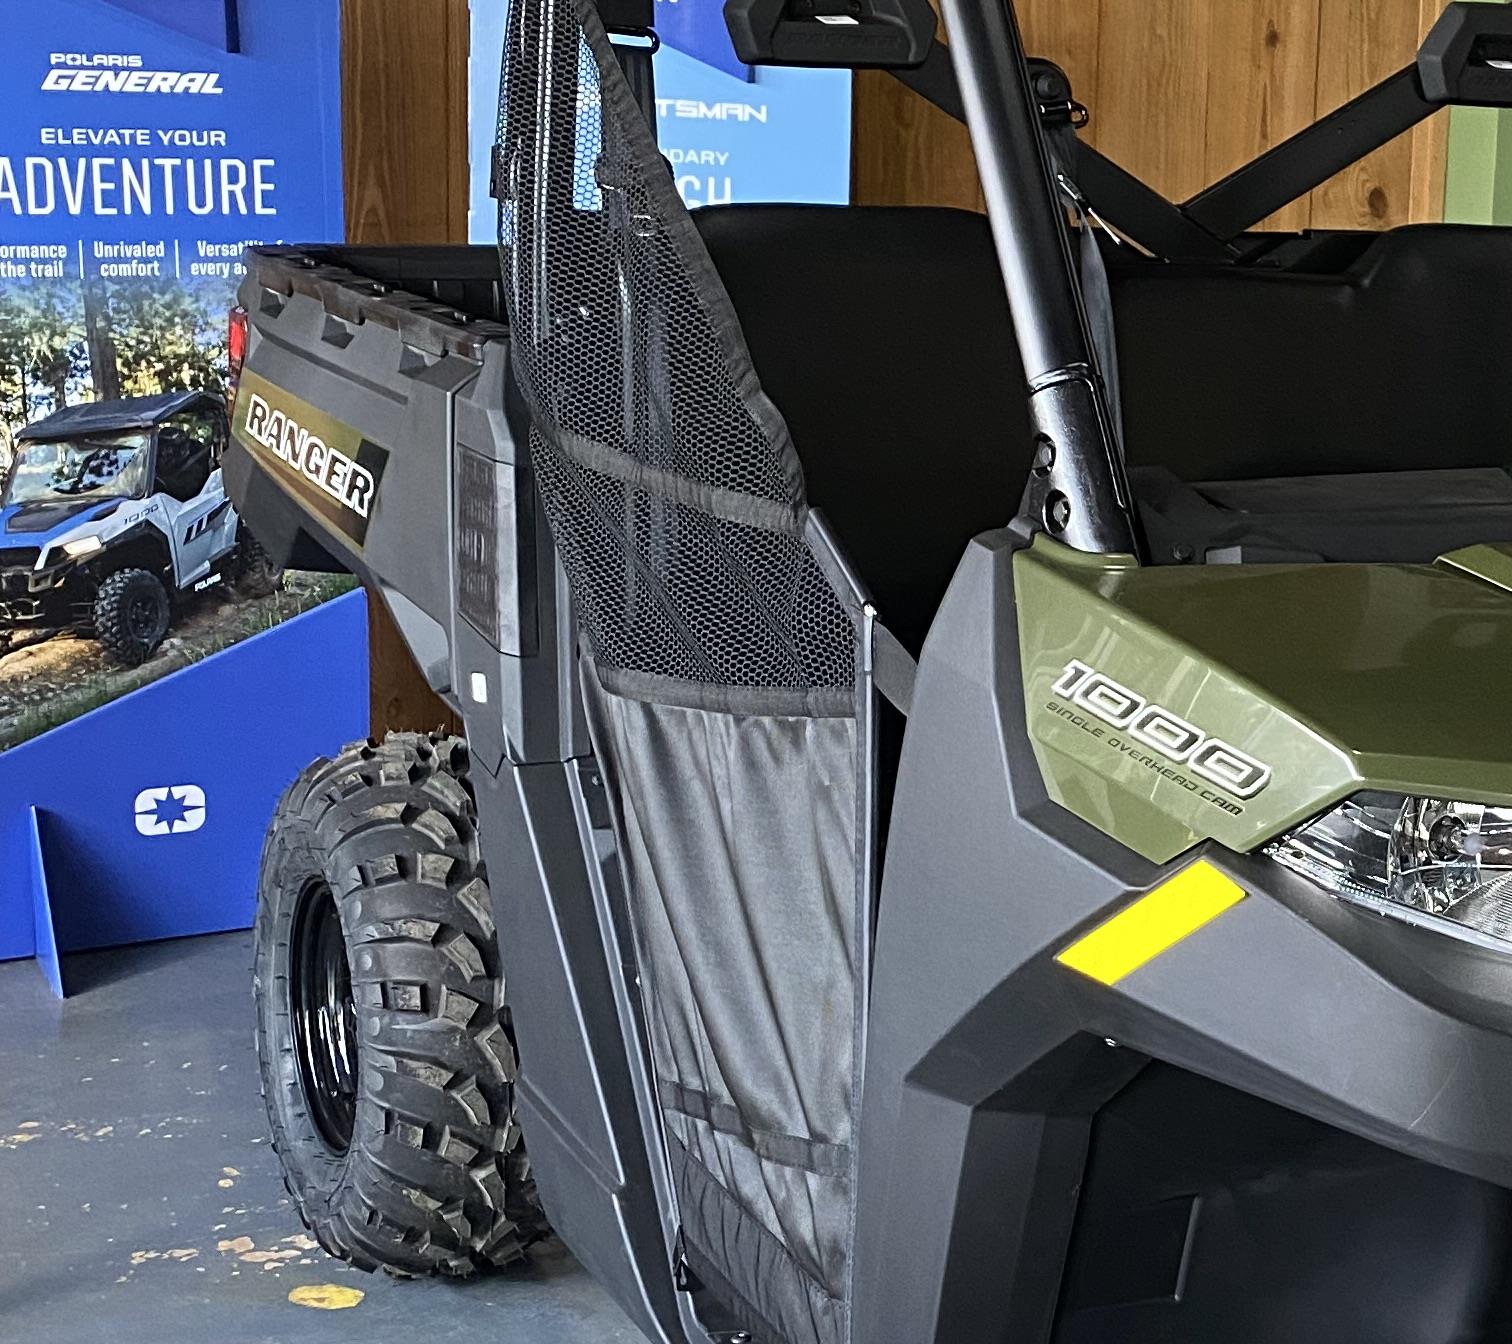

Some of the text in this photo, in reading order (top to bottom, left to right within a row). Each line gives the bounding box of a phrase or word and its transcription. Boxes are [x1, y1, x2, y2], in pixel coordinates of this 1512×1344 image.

[49, 53, 142, 68] POLARIS
[41, 68, 224, 94] GENERAL
[655, 99, 767, 124] TSMAN
[40, 128, 227, 148] ELEVATE YOUR
[0, 156, 278, 216] ADVENTURE
[0, 244, 68, 259] ormance
[93, 240, 165, 258] Unrivaled
[0, 259, 64, 278] the trail
[100, 260, 160, 278] comfort
[190, 262, 230, 278] every
[245, 393, 375, 518] RANGER
[1051, 657, 1272, 800] 1000
[1044, 700, 1246, 817] SINGLE OVERHEAD CAM
